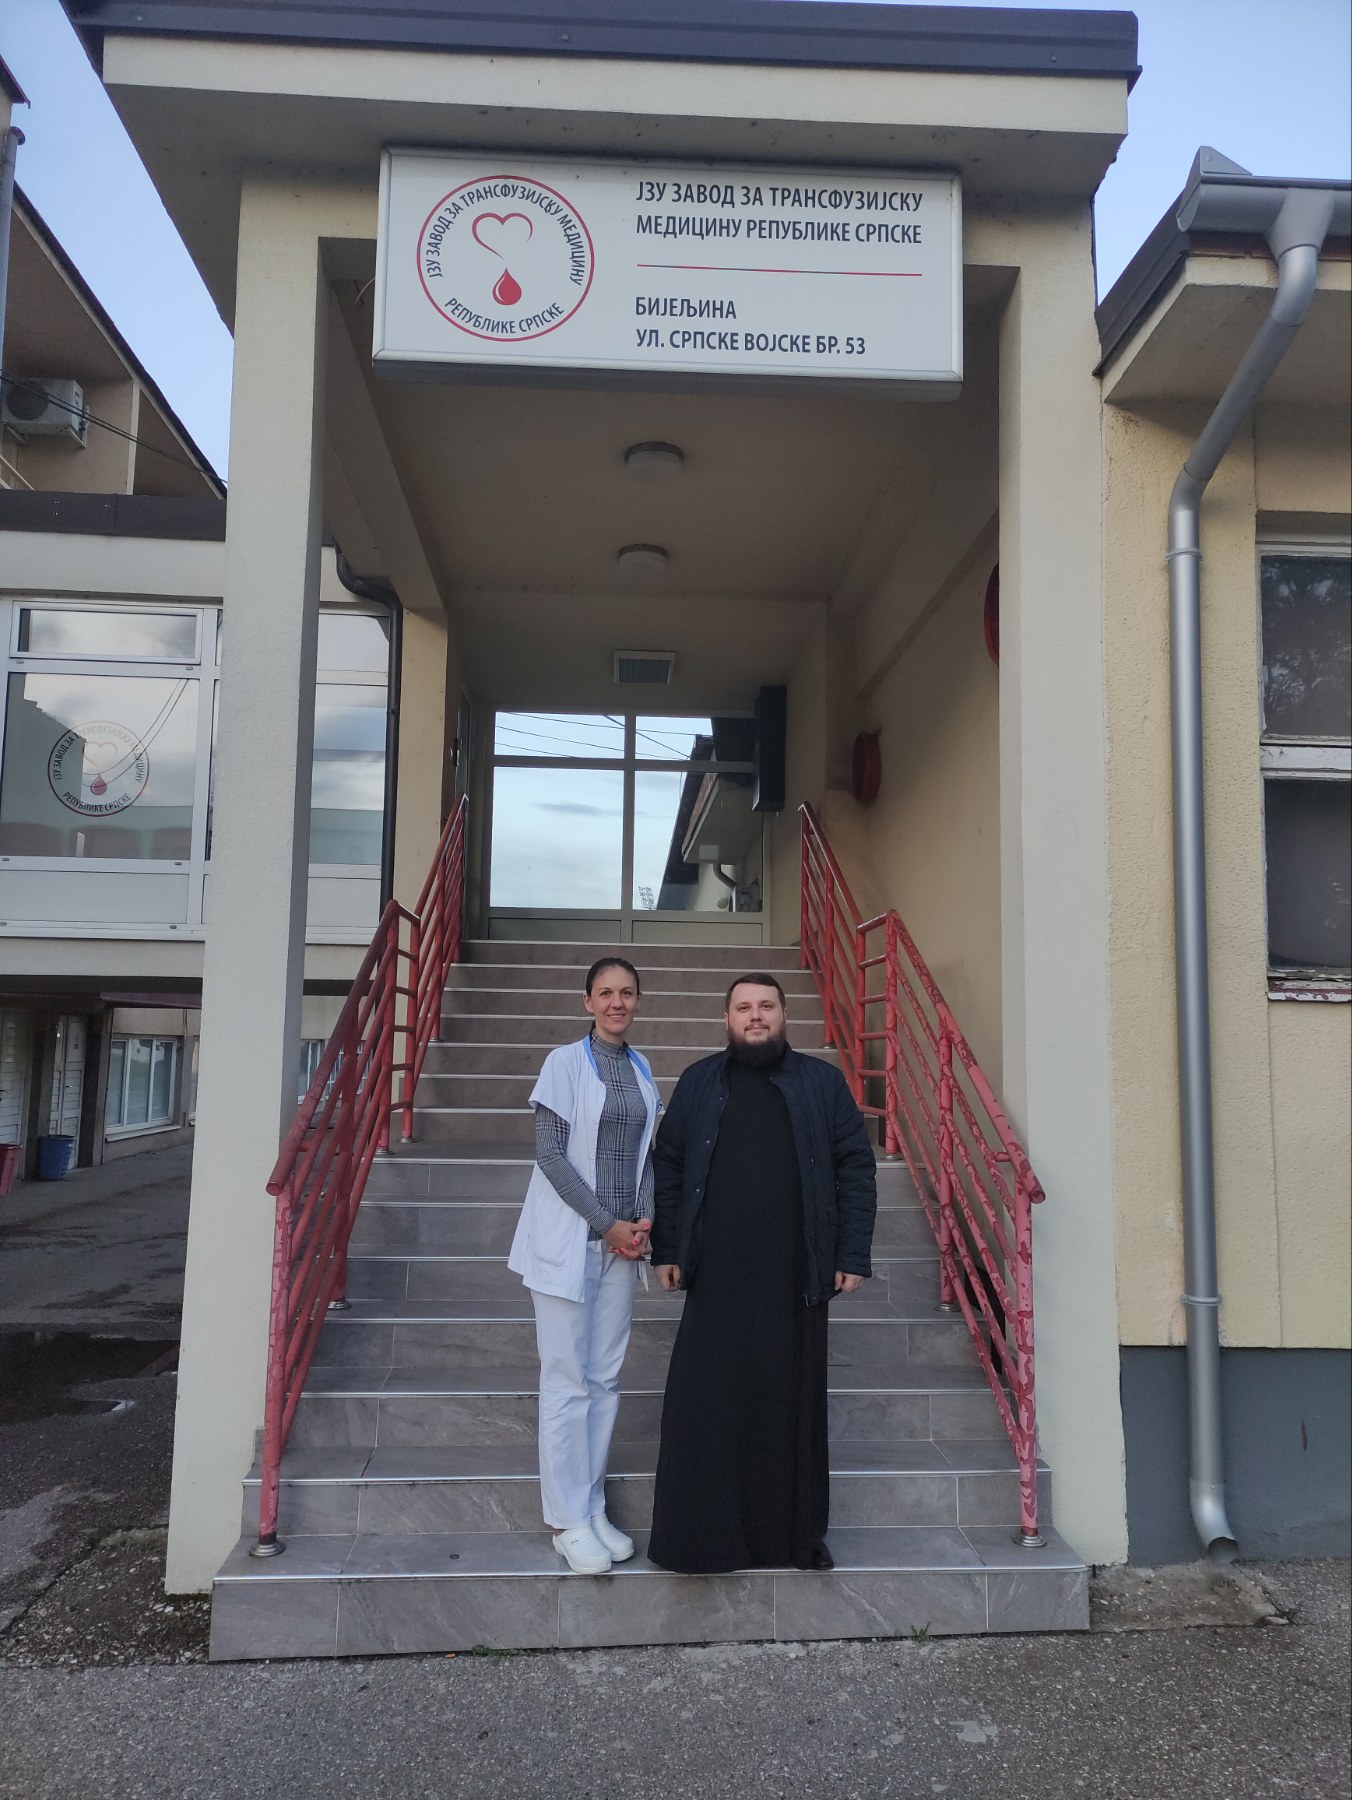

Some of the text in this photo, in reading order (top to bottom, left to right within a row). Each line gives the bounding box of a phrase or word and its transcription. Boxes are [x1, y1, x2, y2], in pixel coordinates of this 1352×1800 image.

[636, 181, 923, 212] ЈЗУ ЗАВОД ЗА ТРАНСФУЗИЈСКУ
[426, 183, 586, 286] ЈЗУ ЗАВОД ЗА ТРАНСФУЗИЈСКУ МЕДИЦИНУ
[636, 215, 922, 243] МЕДИЦИНУ РЕПУБЛИКЕ СРПСКЕ
[444, 297, 564, 334] РЕПУБЛИКЕ СРПСКЕ
[635, 297, 737, 319] БИЈЕЉИНА
[636, 329, 866, 354] УЛ. СРПСКЕ ВОЈСКЕ БР. 53
